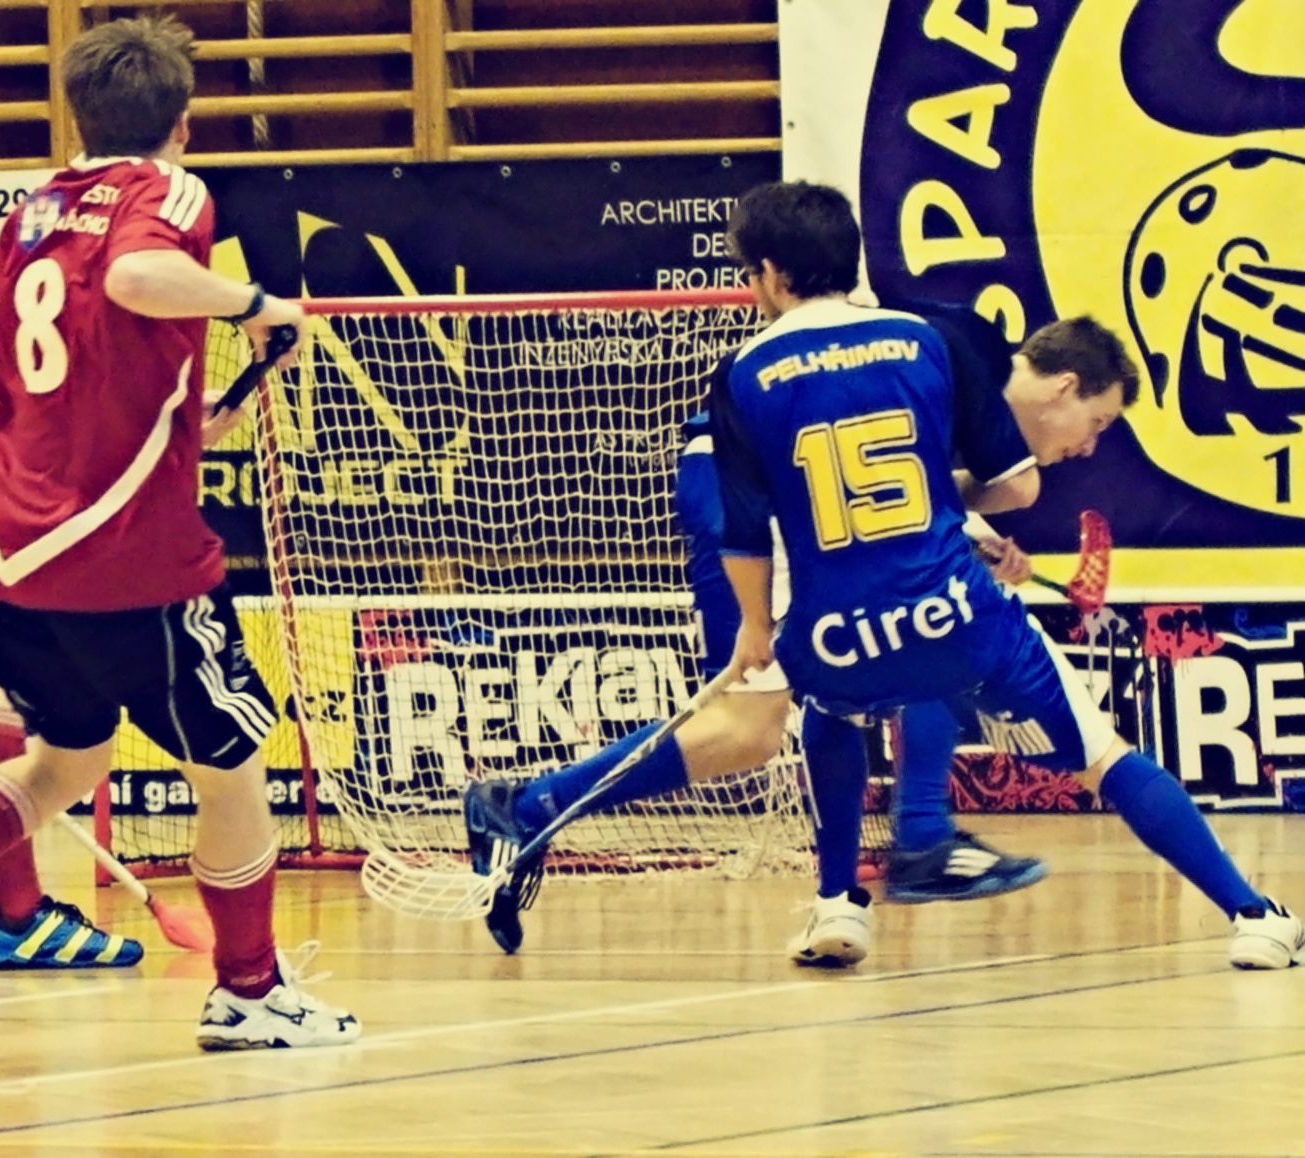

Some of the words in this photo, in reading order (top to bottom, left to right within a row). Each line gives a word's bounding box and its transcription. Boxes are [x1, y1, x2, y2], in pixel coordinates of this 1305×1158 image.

[13, 257, 69, 395] 8
[656, 267, 748, 290] PROJEK
[197, 459, 469, 507] ROJECT
[793, 407, 933, 552] 15
[1264, 446, 1292, 504] 1
[1172, 654, 1305, 786] RE
